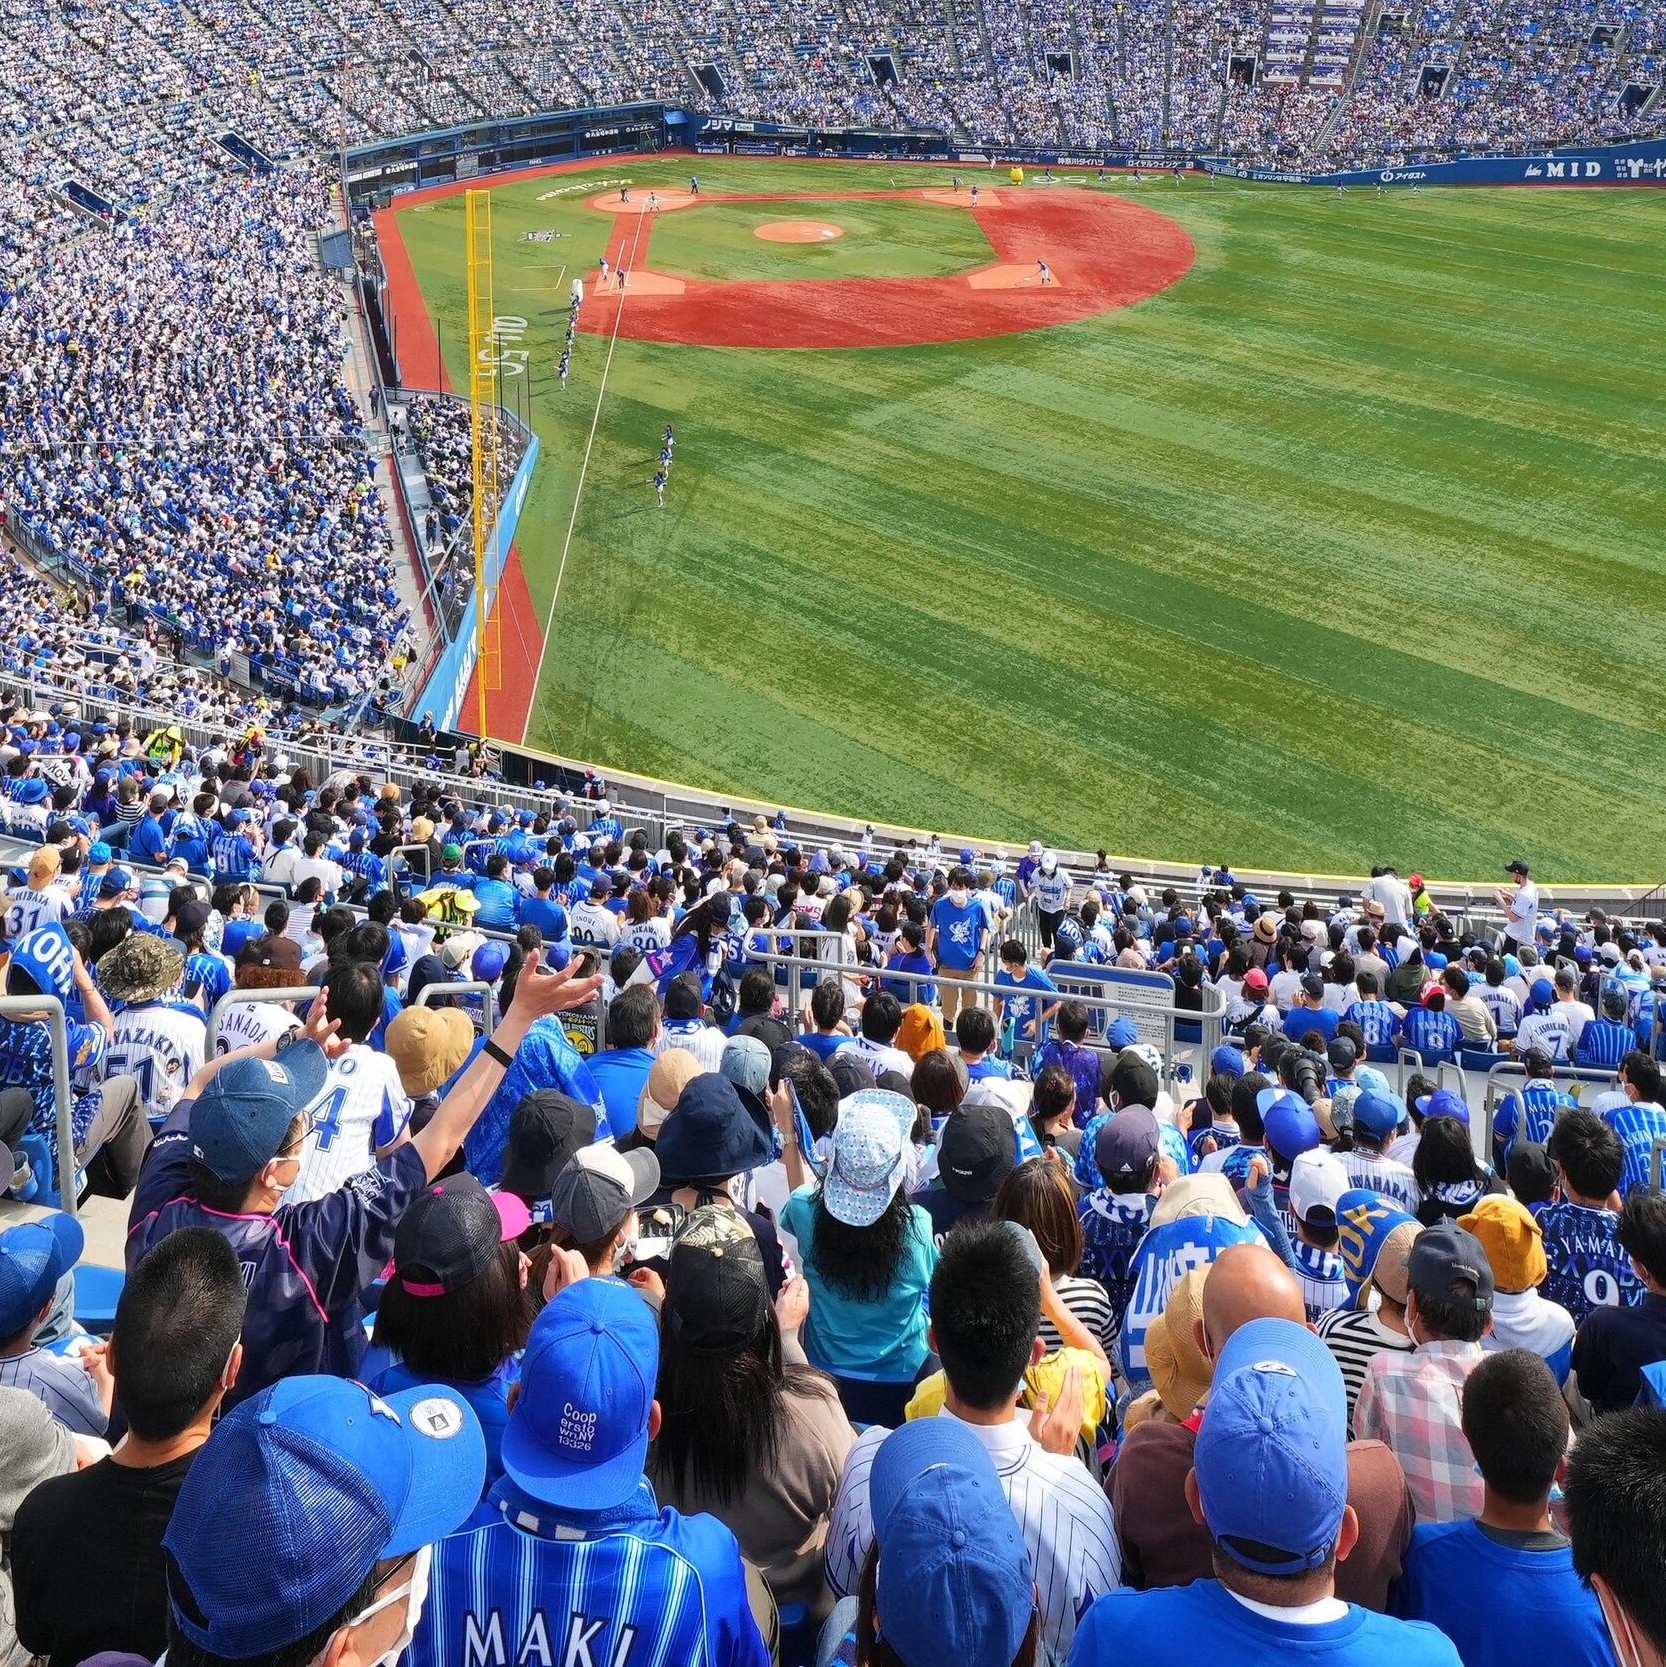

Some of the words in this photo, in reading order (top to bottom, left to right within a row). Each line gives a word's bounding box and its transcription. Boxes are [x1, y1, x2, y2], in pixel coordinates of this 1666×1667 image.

[701, 119, 733, 131] ノジマ
[1363, 1019, 1380, 1046] 8
[1547, 1034, 1563, 1060] 7
[1585, 1268, 1621, 1307] 9
[563, 1402, 597, 1424] Coop
[560, 1418, 596, 1434] ersto
[558, 1435, 592, 1451] 13326
[464, 1606, 640, 1667] MAKI
